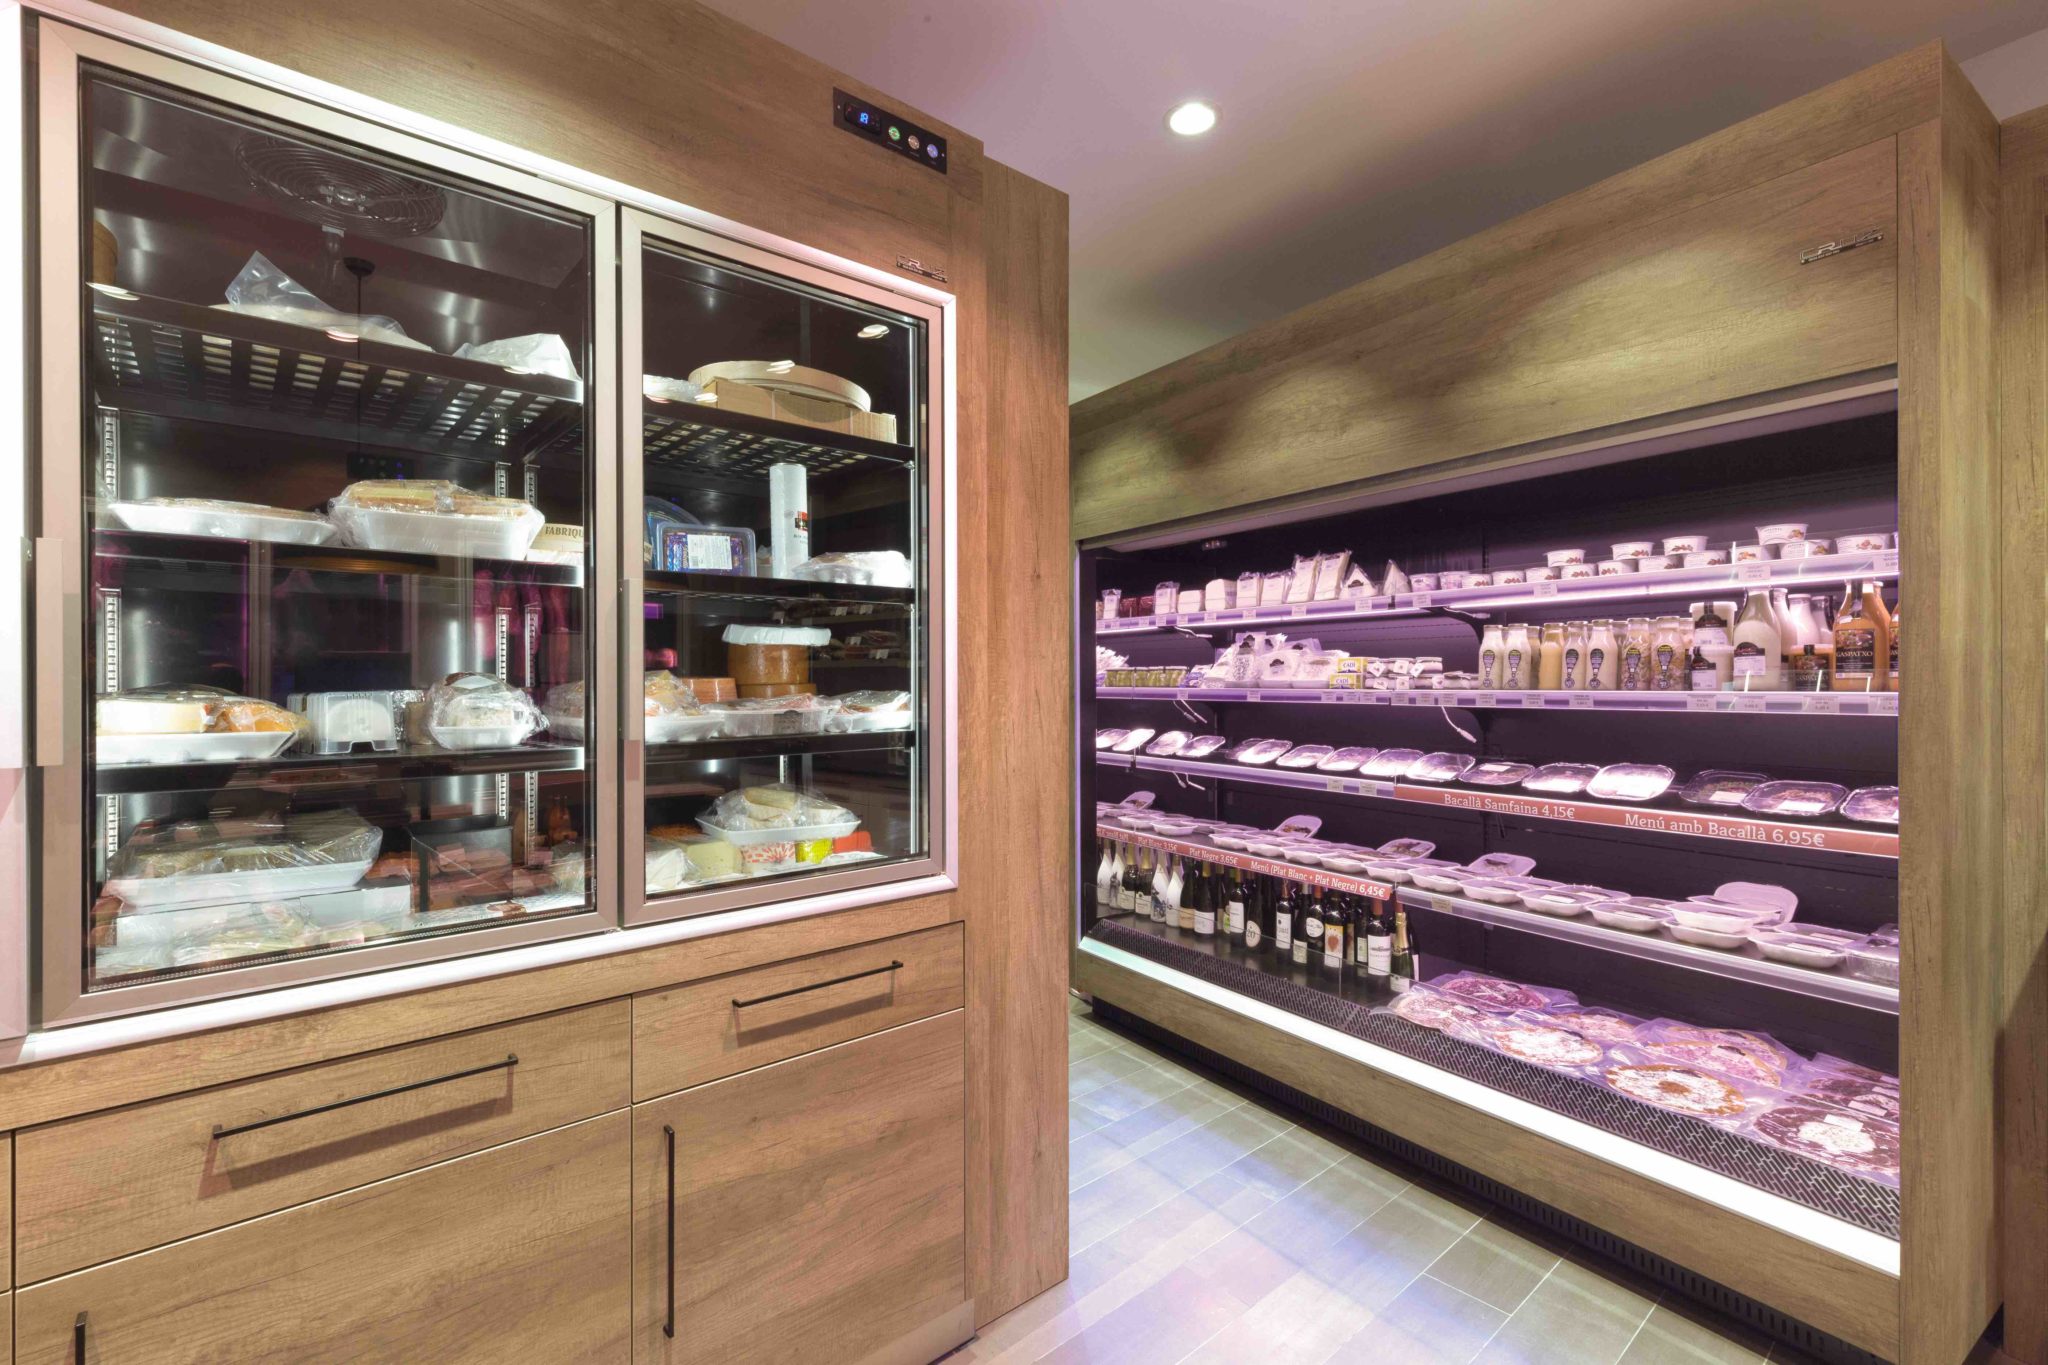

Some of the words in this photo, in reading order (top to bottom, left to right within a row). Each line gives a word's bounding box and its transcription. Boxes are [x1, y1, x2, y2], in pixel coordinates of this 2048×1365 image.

[1444, 794, 1481, 808] Bacallà
[1485, 798, 1538, 815] Samfaina
[1541, 805, 1575, 819] 4,15€
[1625, 813, 1665, 830] Menú
[1670, 820, 1703, 834] amb
[1708, 822, 1766, 841] Bacallà
[1772, 829, 1825, 847] 6,95€
[1189, 848, 1200, 857] Plat
[1201, 850, 1219, 861] Negre
[1220, 854, 1239, 866] 3,65€
[1251, 860, 1269, 873] Menú
[1271, 865, 1287, 876] (Plat
[1288, 868, 1307, 881] Blanc
[1315, 874, 1330, 886] Plat
[1331, 879, 1358, 893] Negre)
[1359, 883, 1386, 898] 6,45€
